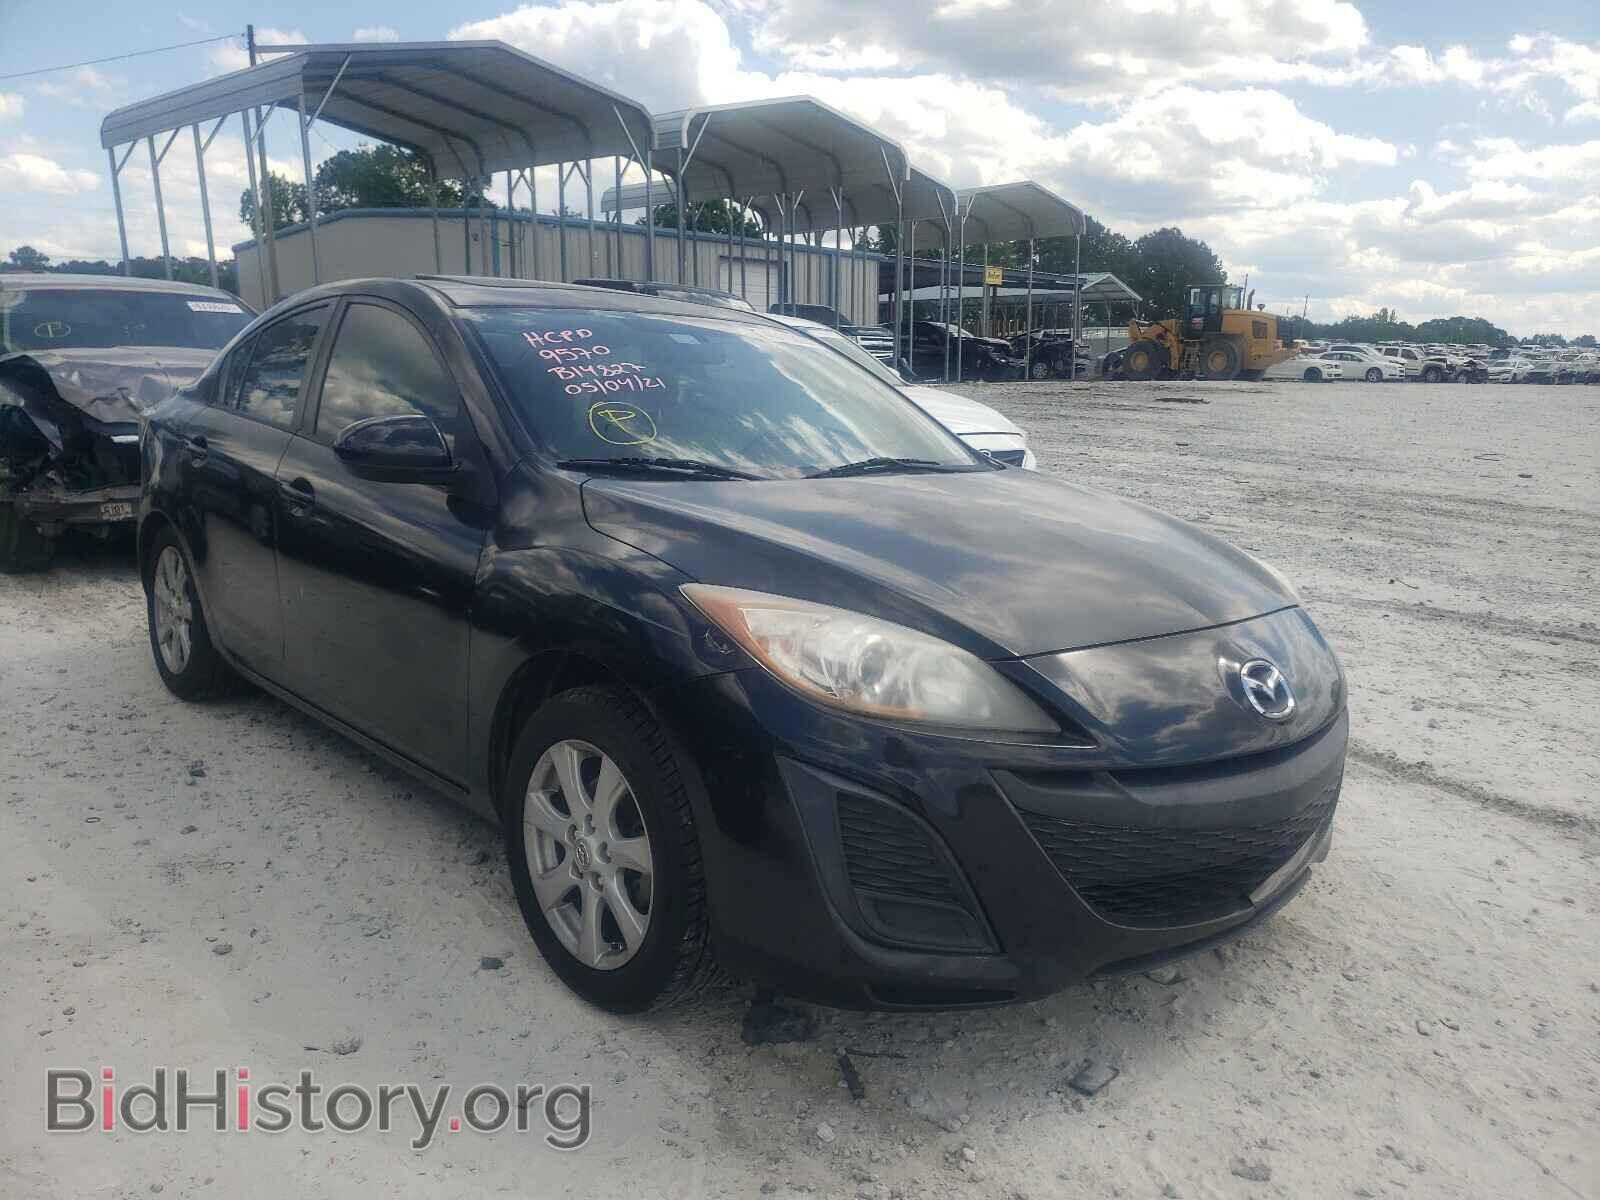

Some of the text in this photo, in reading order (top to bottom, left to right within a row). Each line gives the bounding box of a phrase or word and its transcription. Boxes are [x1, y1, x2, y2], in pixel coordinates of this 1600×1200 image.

[522, 328, 593, 348] HCPD
[538, 345, 611, 364] 9570
[547, 362, 647, 380] B14827
[565, 375, 666, 395] 05/04/21
